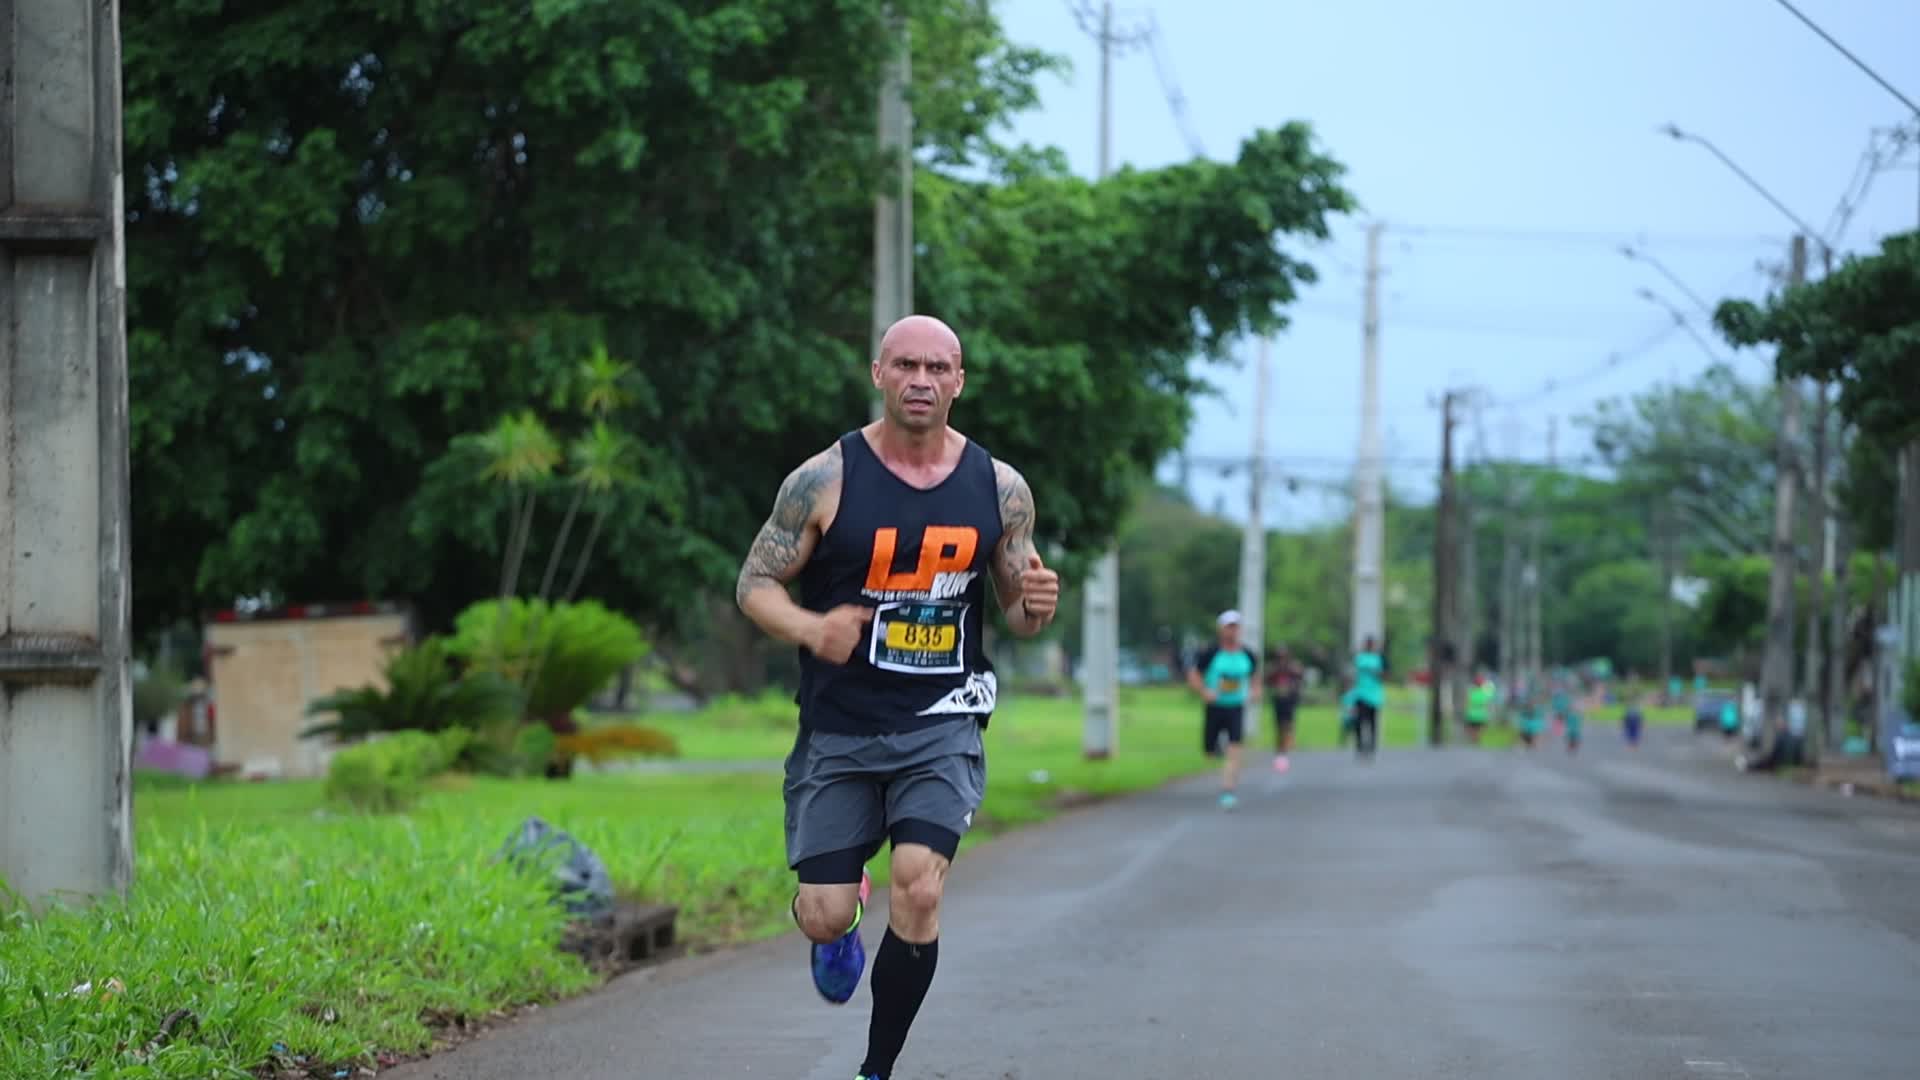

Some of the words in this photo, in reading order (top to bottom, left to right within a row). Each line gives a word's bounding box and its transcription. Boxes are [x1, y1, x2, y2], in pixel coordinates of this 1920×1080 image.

[864, 525, 979, 591] LP
[929, 571, 978, 600] RUN
[904, 624, 942, 647] 835
